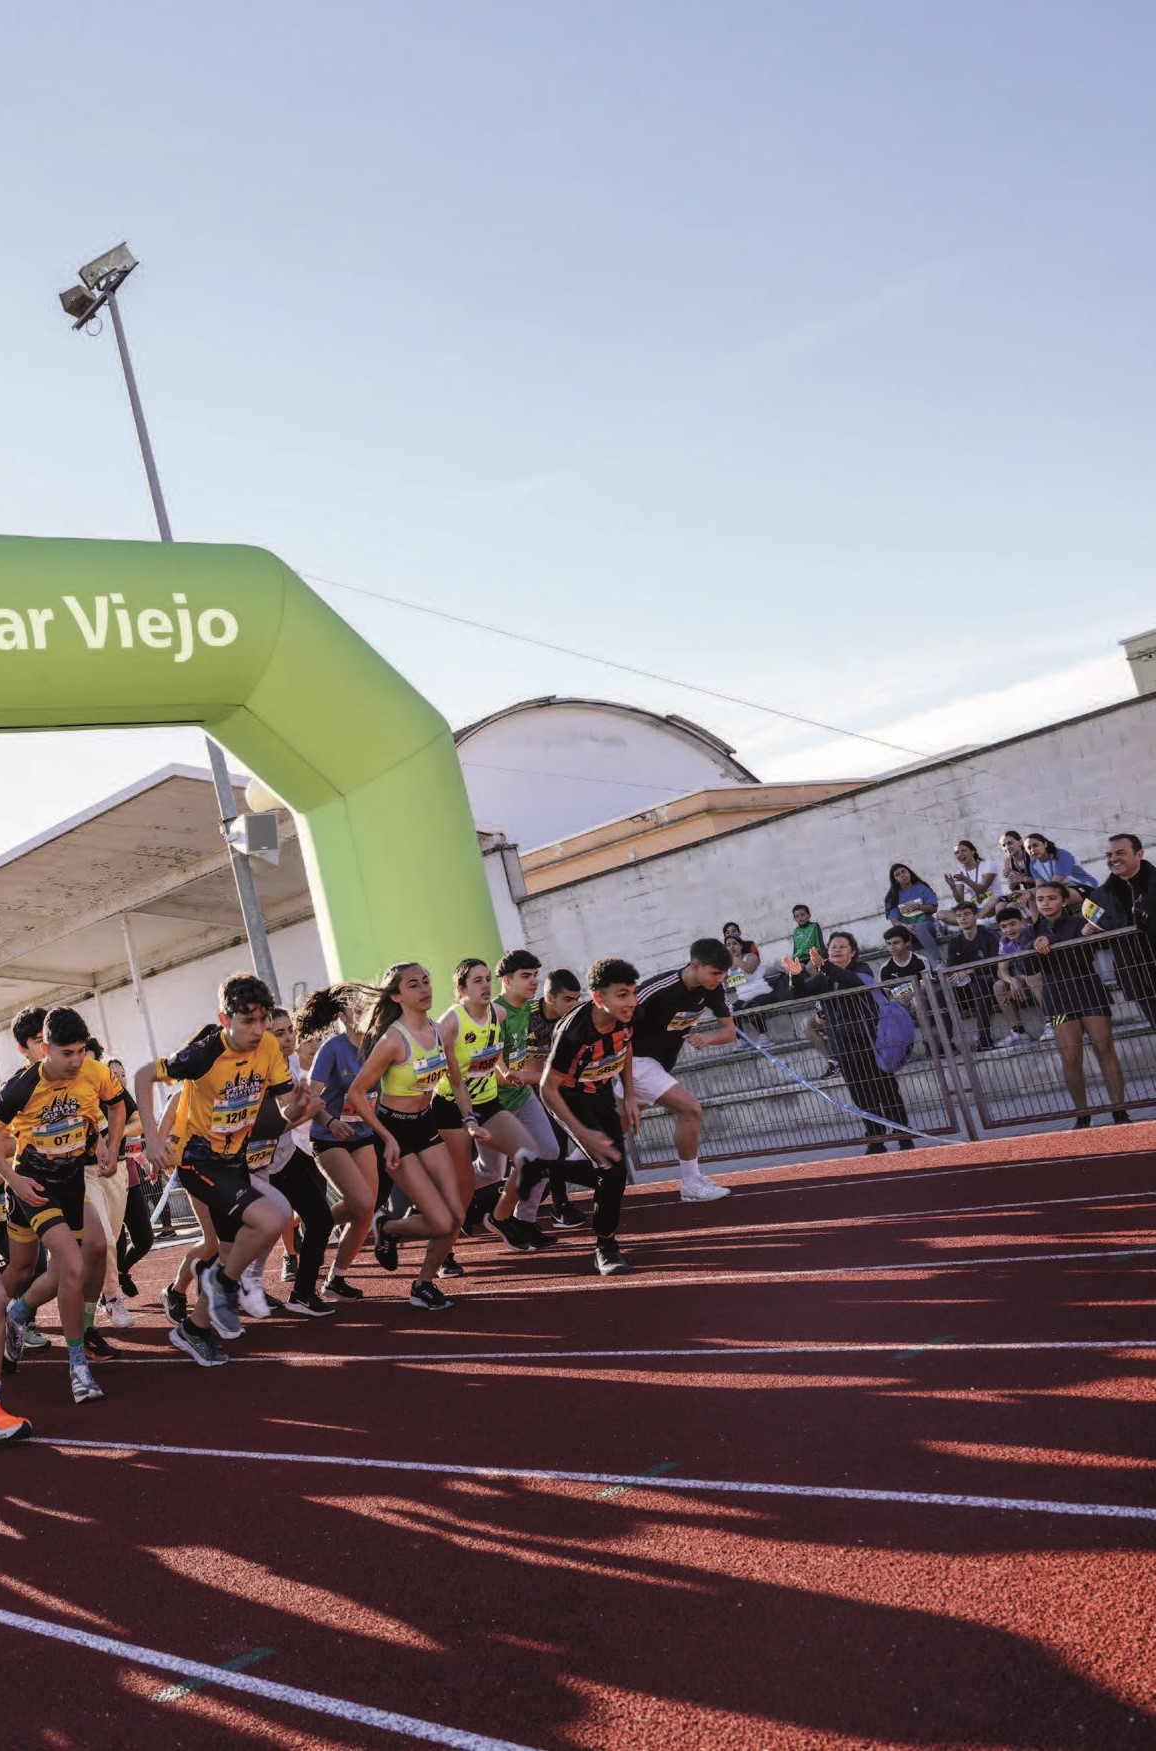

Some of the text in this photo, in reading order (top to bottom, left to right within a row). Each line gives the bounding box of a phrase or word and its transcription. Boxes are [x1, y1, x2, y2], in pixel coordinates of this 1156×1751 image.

[62, 592, 239, 663] Viejo
[225, 1108, 248, 1124] 1218
[53, 1133, 71, 1146] 07
[248, 1150, 265, 1164] 573
